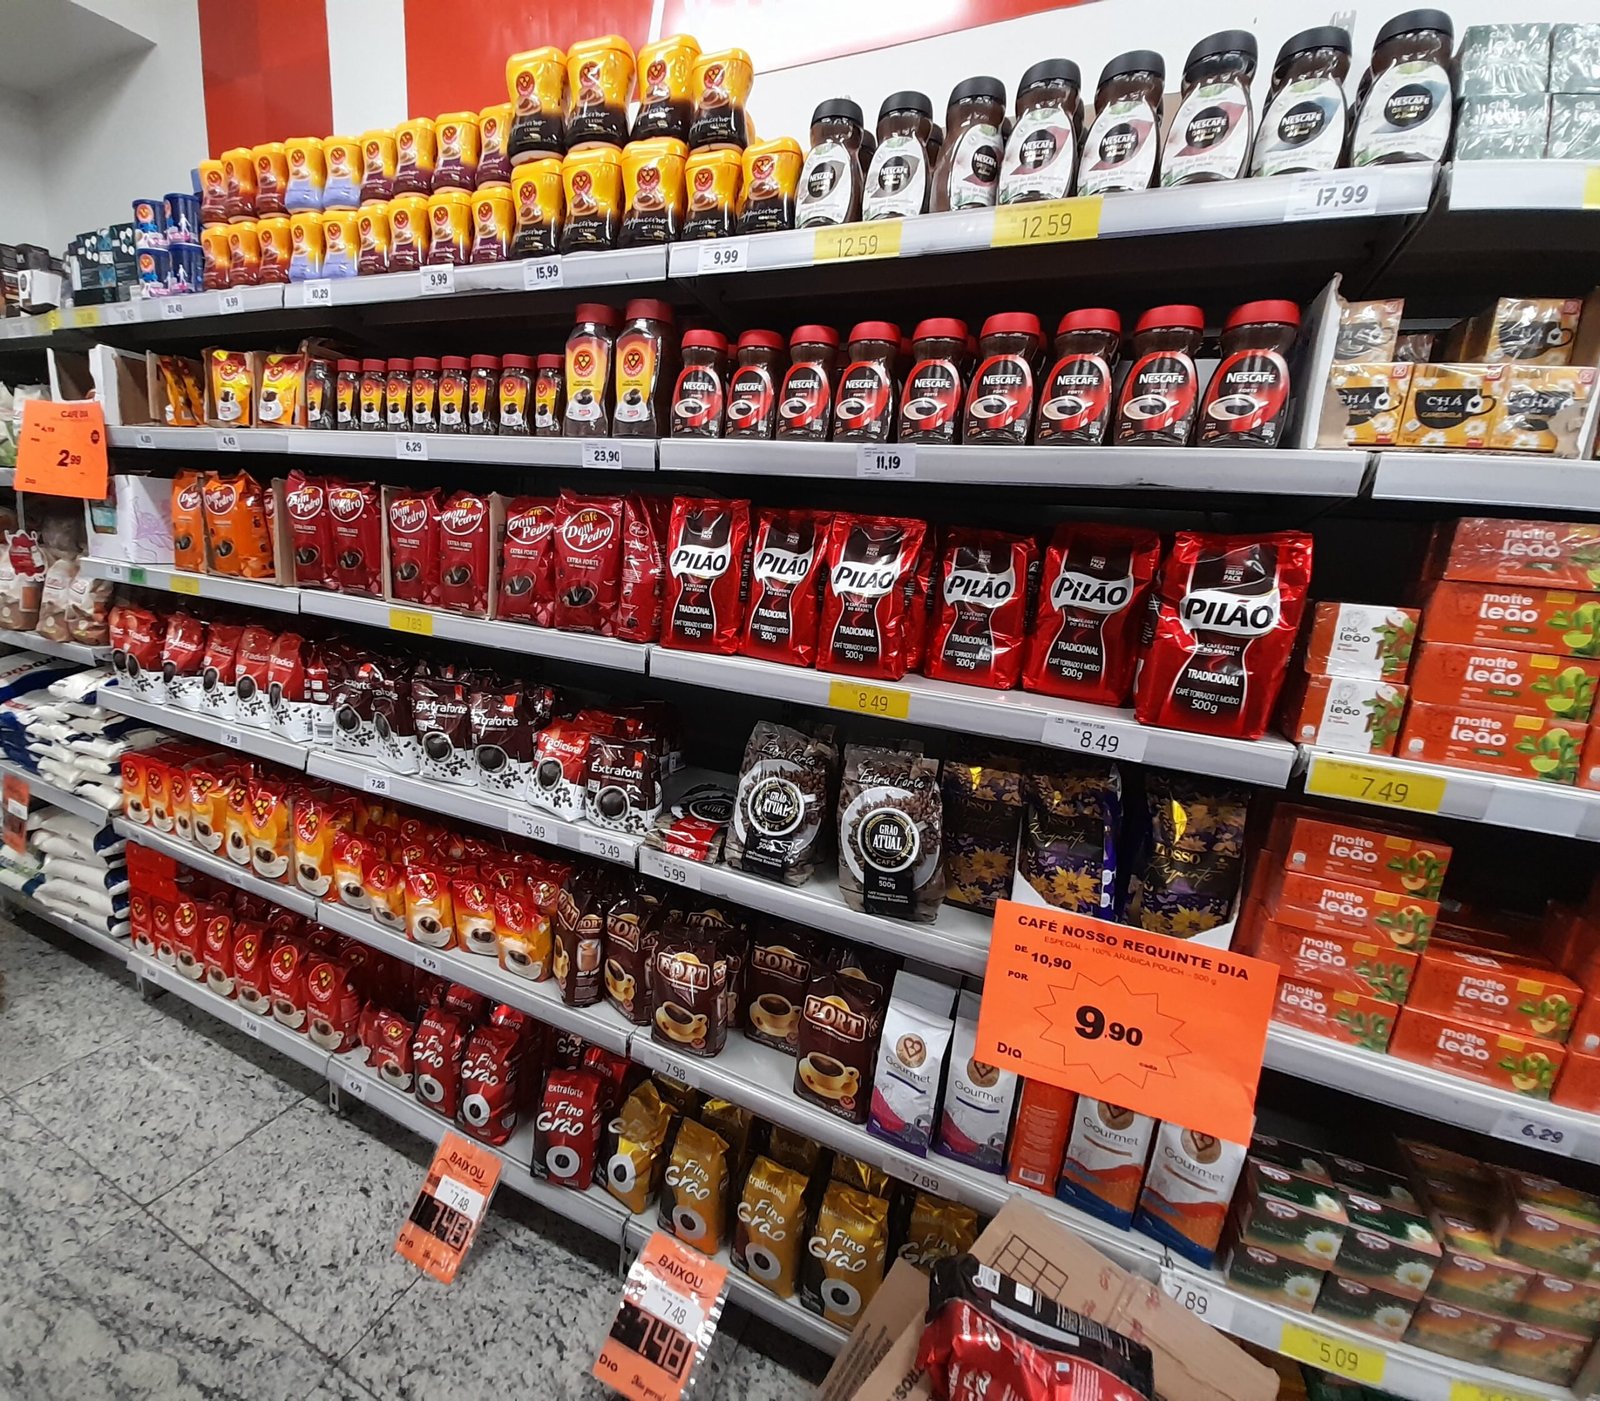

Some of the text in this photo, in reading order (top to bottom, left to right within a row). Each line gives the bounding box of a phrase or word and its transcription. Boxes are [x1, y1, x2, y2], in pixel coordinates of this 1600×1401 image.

[1316, 184, 1369, 207] 17,99
[714, 249, 738, 265] 9,99
[430, 273, 448, 287] 9,99
[536, 264, 558, 280] 15,99
[1425, 394, 1463, 407] CHÁ
[405, 441, 422, 453] 6,29
[594, 450, 620, 464] 23,90
[876, 455, 901, 471] 11,19
[578, 526, 611, 546] Pedro
[674, 550, 726, 572] PILÃO
[758, 552, 809, 576] PILÃO
[833, 566, 895, 590] PILÃO
[946, 575, 1011, 600] PILÃO
[1054, 577, 1128, 605] PILÃO
[1482, 592, 1533, 606] matte
[1184, 597, 1277, 630] PILÃO
[1478, 602, 1538, 623] leão
[1339, 631, 1370, 644] leão
[1469, 656, 1518, 670] matte
[1187, 667, 1240, 687] TRADICIONAL
[1464, 665, 1523, 687] leão
[1330, 704, 1361, 717] leão
[1454, 714, 1502, 729] matte
[1080, 730, 1120, 753] 8.49
[1450, 725, 1506, 746] leão
[879, 822, 899, 836] GRÃO
[872, 834, 903, 851] ATUAL
[1332, 832, 1374, 849] matte
[1328, 843, 1378, 864] leão
[1322, 887, 1364, 904] matte
[1318, 897, 1368, 918] leão
[1018, 915, 1249, 981] CAFÉ NOSSO REQUINTE DIA
[1044, 936, 1082, 951] ESPECIAL
[1301, 935, 1343, 953] matte
[753, 952, 807, 978] FORT
[1014, 944, 1072, 970] DE 10,90
[659, 954, 708, 984] FORT
[1283, 981, 1323, 1000] matte
[1461, 975, 1506, 992] matte
[1457, 984, 1509, 1006] leão
[807, 1000, 864, 1036] FORT
[1441, 1027, 1486, 1046] matte
[1437, 1036, 1490, 1061] leão
[885, 1055, 931, 1084] Gourmet
[954, 1079, 1004, 1105] Gourmet
[555, 1100, 584, 1118] Fino
[536, 1110, 584, 1136] Grão
[1083, 1116, 1139, 1147] Gourmet
[1520, 1123, 1564, 1145] 6,29
[449, 1151, 486, 1180] BAIXOU
[684, 1159, 709, 1183] Fino
[1164, 1146, 1225, 1183] Gourmet
[664, 1165, 710, 1201] Grão
[737, 1201, 786, 1241] Grão
[755, 1199, 785, 1225] Fino
[830, 1227, 866, 1254] Fino
[808, 1236, 867, 1272] Grão
[657, 1254, 704, 1290] BAIXOU
